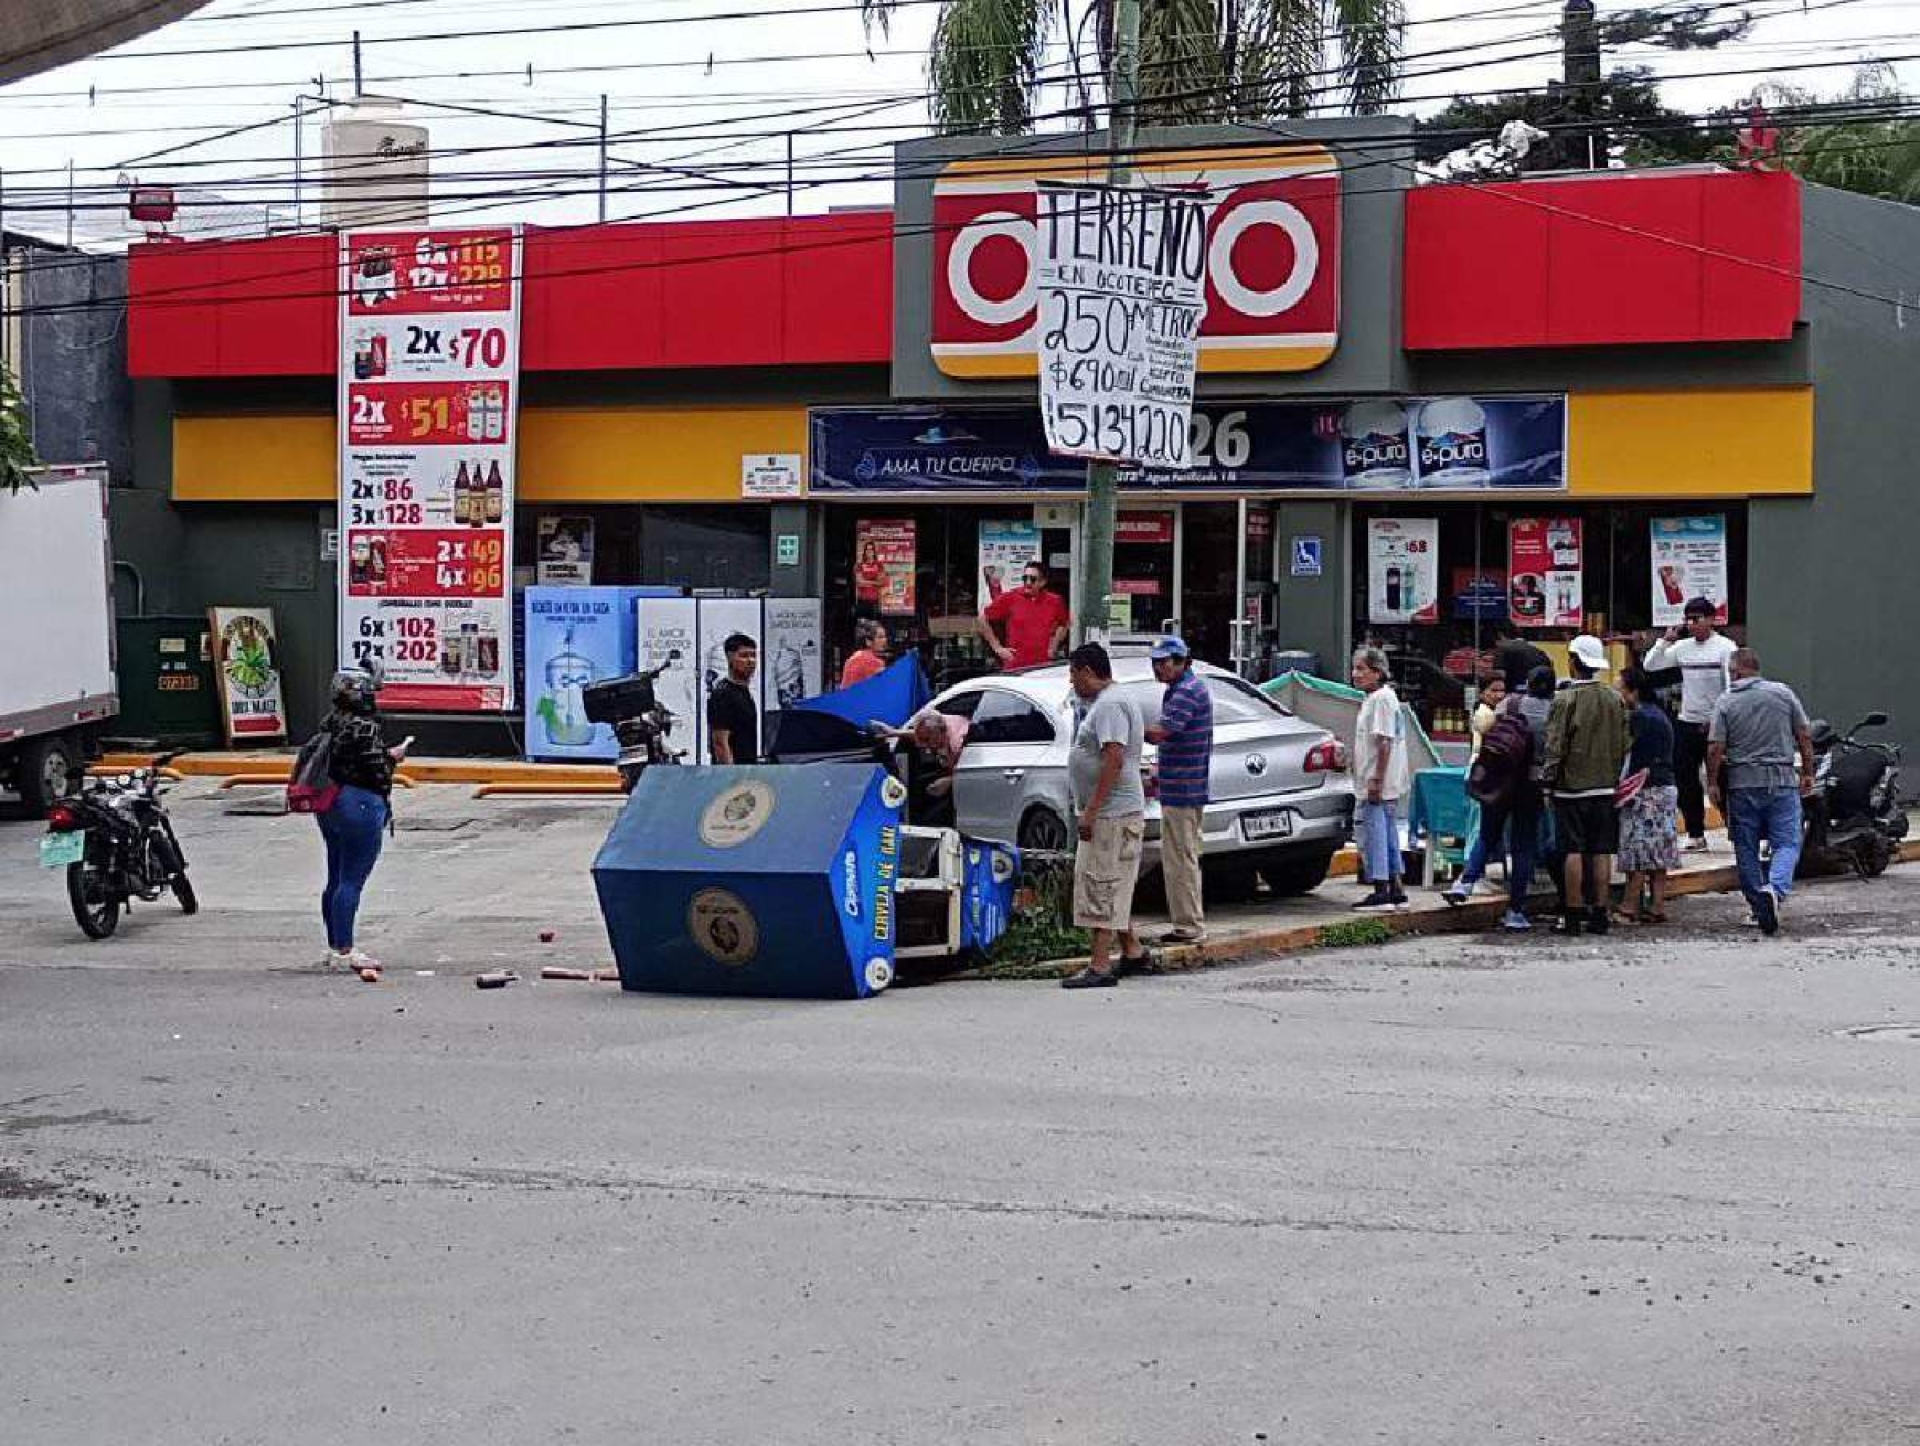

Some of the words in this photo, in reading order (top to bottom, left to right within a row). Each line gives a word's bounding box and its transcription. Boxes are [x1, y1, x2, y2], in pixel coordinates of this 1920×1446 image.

[1038, 189, 1206, 282] TERRENO
[1045, 291, 1129, 356] 250
[449, 327, 506, 369] $70
[881, 457, 920, 476] AMA
[926, 457, 946, 474] TU
[948, 457, 1017, 473] CUERPO
[352, 479, 373, 499] 2x
[352, 503, 375, 525] 3x
[360, 616, 385, 637] 6x
